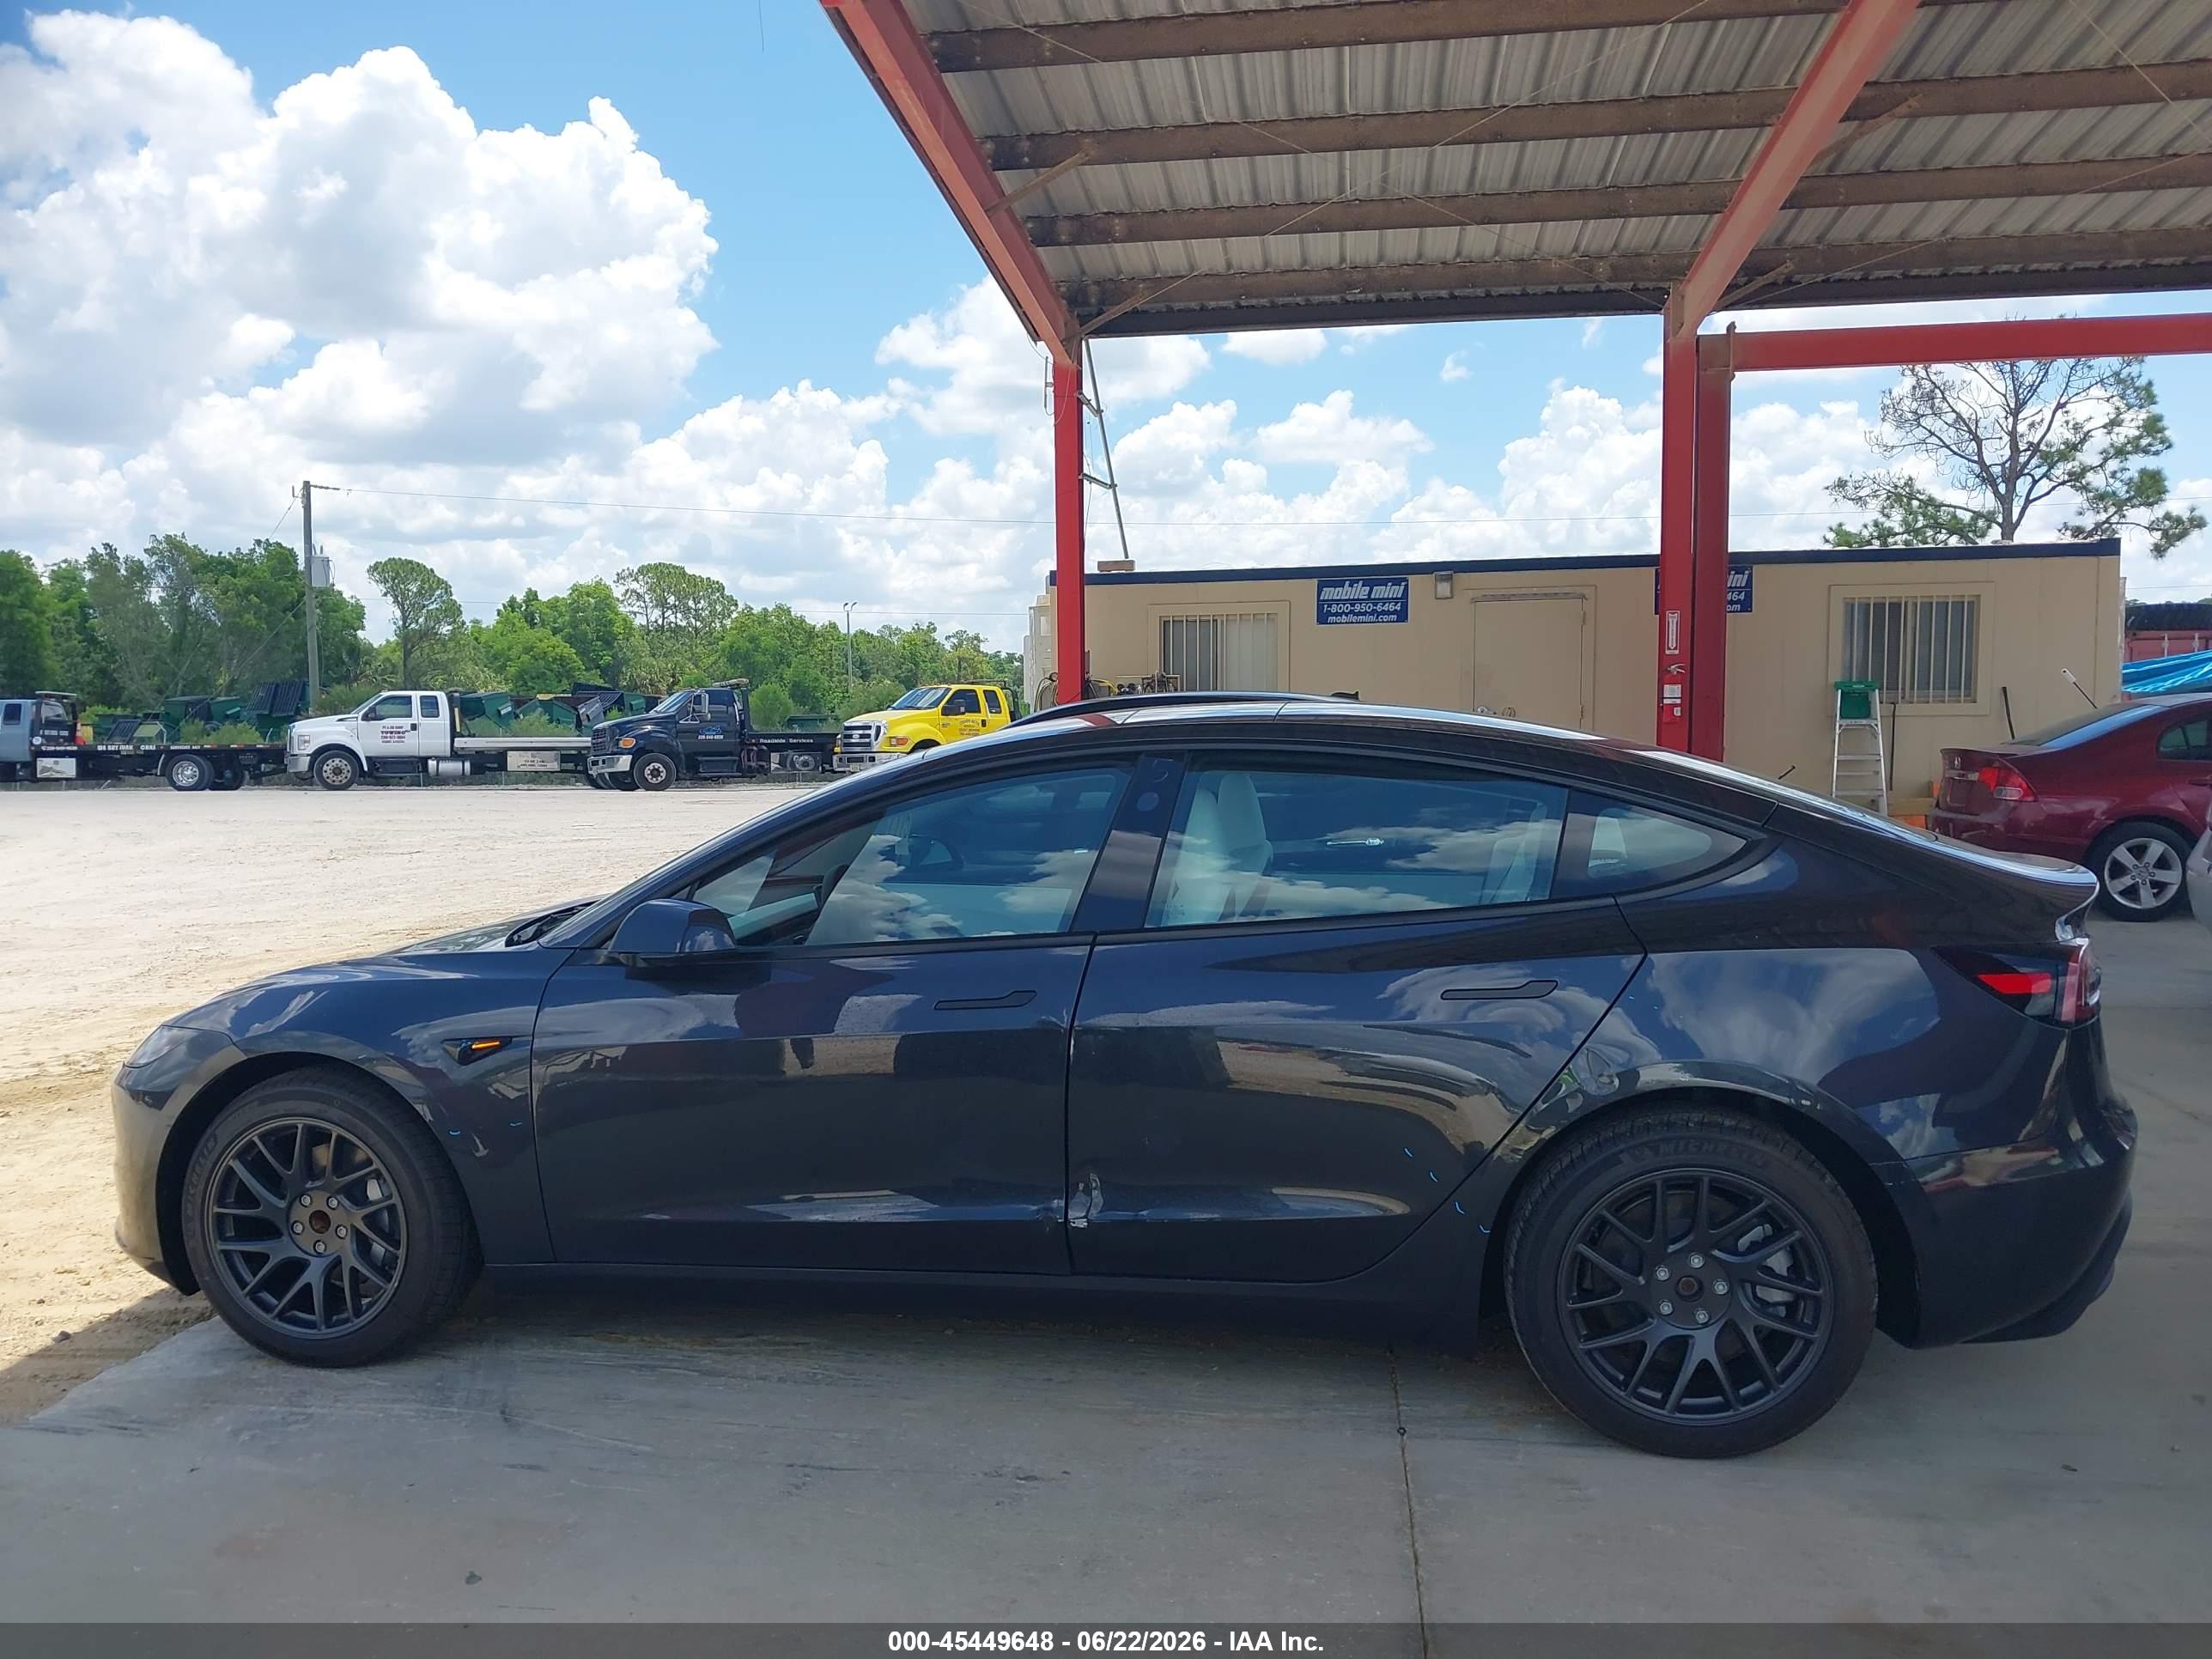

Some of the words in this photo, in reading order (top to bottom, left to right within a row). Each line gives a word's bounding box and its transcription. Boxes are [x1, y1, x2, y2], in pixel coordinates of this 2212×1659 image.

[1727, 570, 1750, 587] ini
[1320, 580, 1370, 599] mobile
[1370, 582, 1407, 599] mini
[1323, 602, 1401, 613] 1-800-950-6464
[1328, 613, 1397, 623] mobilemini.com
